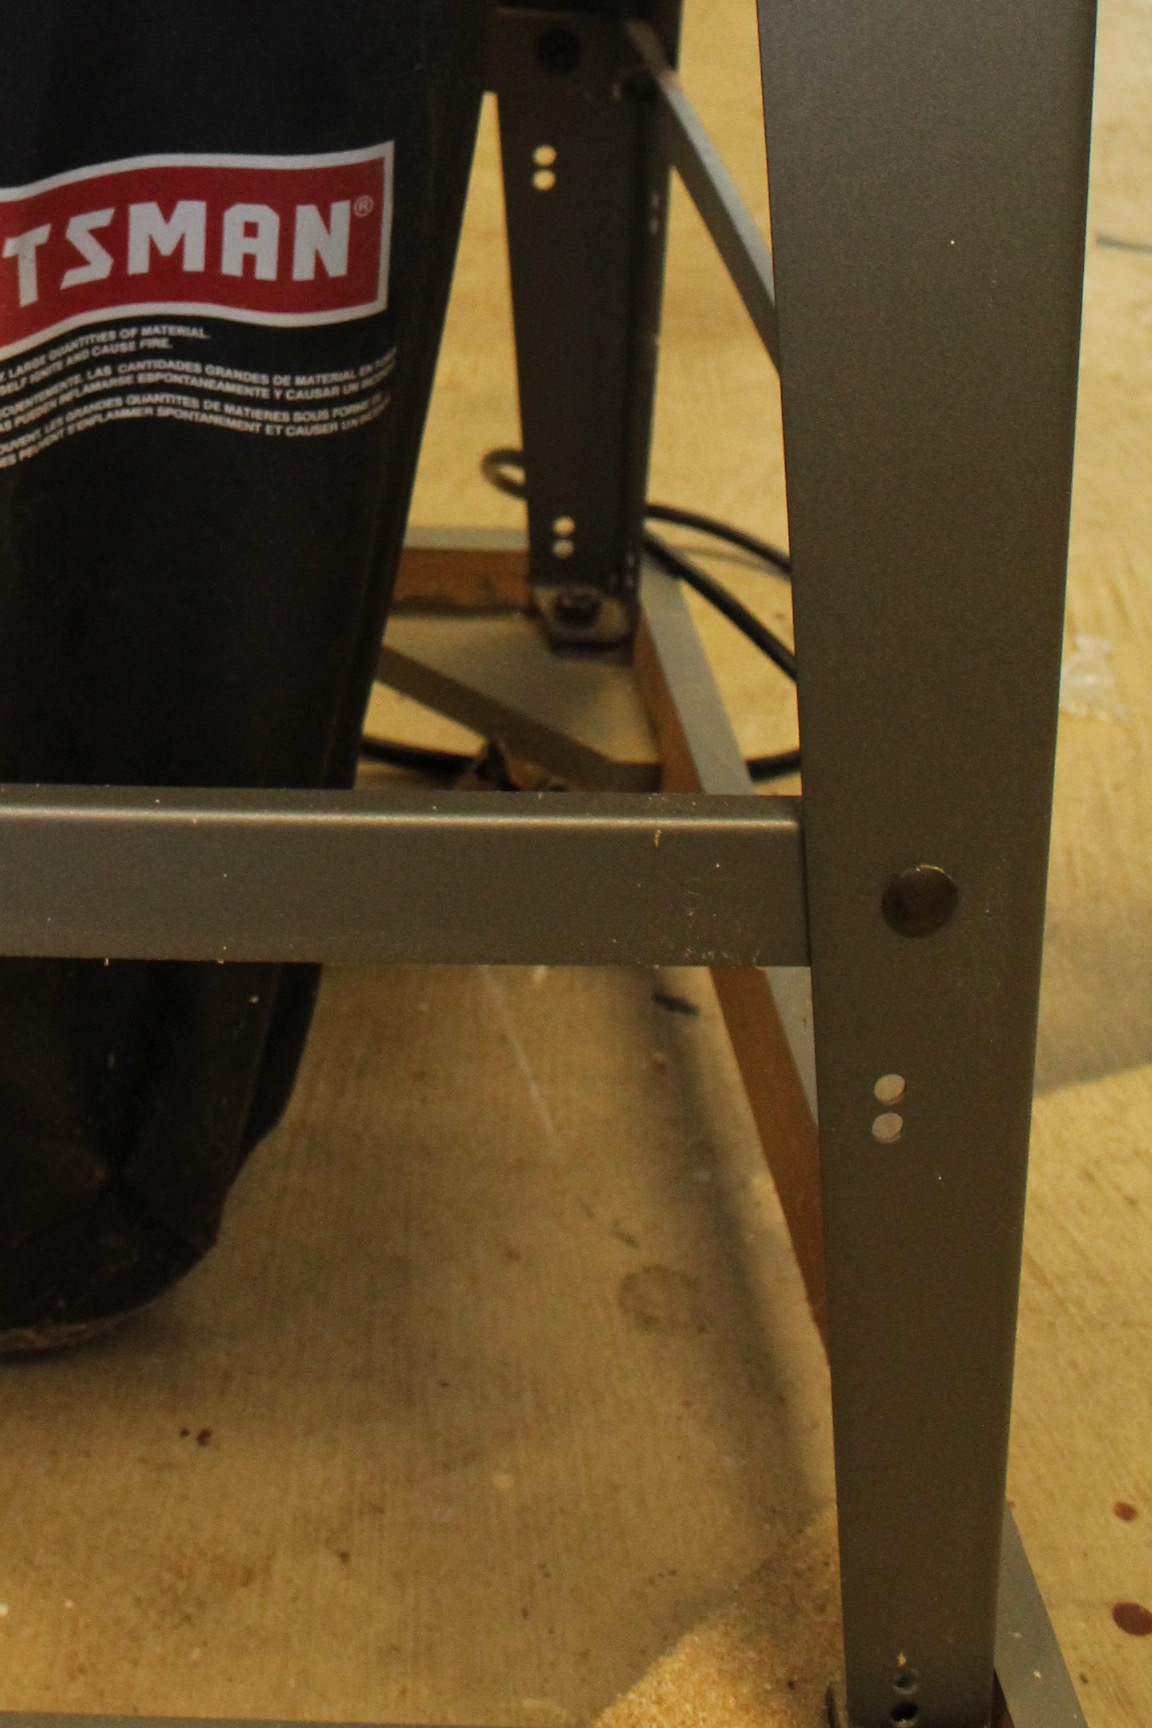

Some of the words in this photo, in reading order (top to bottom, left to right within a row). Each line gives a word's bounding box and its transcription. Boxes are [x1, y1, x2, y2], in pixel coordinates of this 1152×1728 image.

[8, 356, 47, 379] LARGE
[47, 330, 116, 360] QUANTITIES
[119, 329, 139, 340] OF
[65, 351, 90, 366] AND
[91, 342, 136, 357] CAUSE
[86, 367, 112, 380] LAS
[117, 360, 202, 374] CANTIDADES
[205, 363, 270, 386] GRANDES
[272, 376, 291, 387] DE
[294, 370, 356, 386] MATERIAL
[273, 390, 284, 400] Y
[285, 387, 340, 402] CAUSAR
[65, 396, 123, 422] GRANDES
[126, 394, 200, 409] QUANTITES
[203, 401, 221, 413] DE
[223, 401, 290, 423] MATIERES
[293, 410, 329, 423] SOUS
[264, 425, 283, 437] ET
[285, 423, 339, 437] CAUSER
